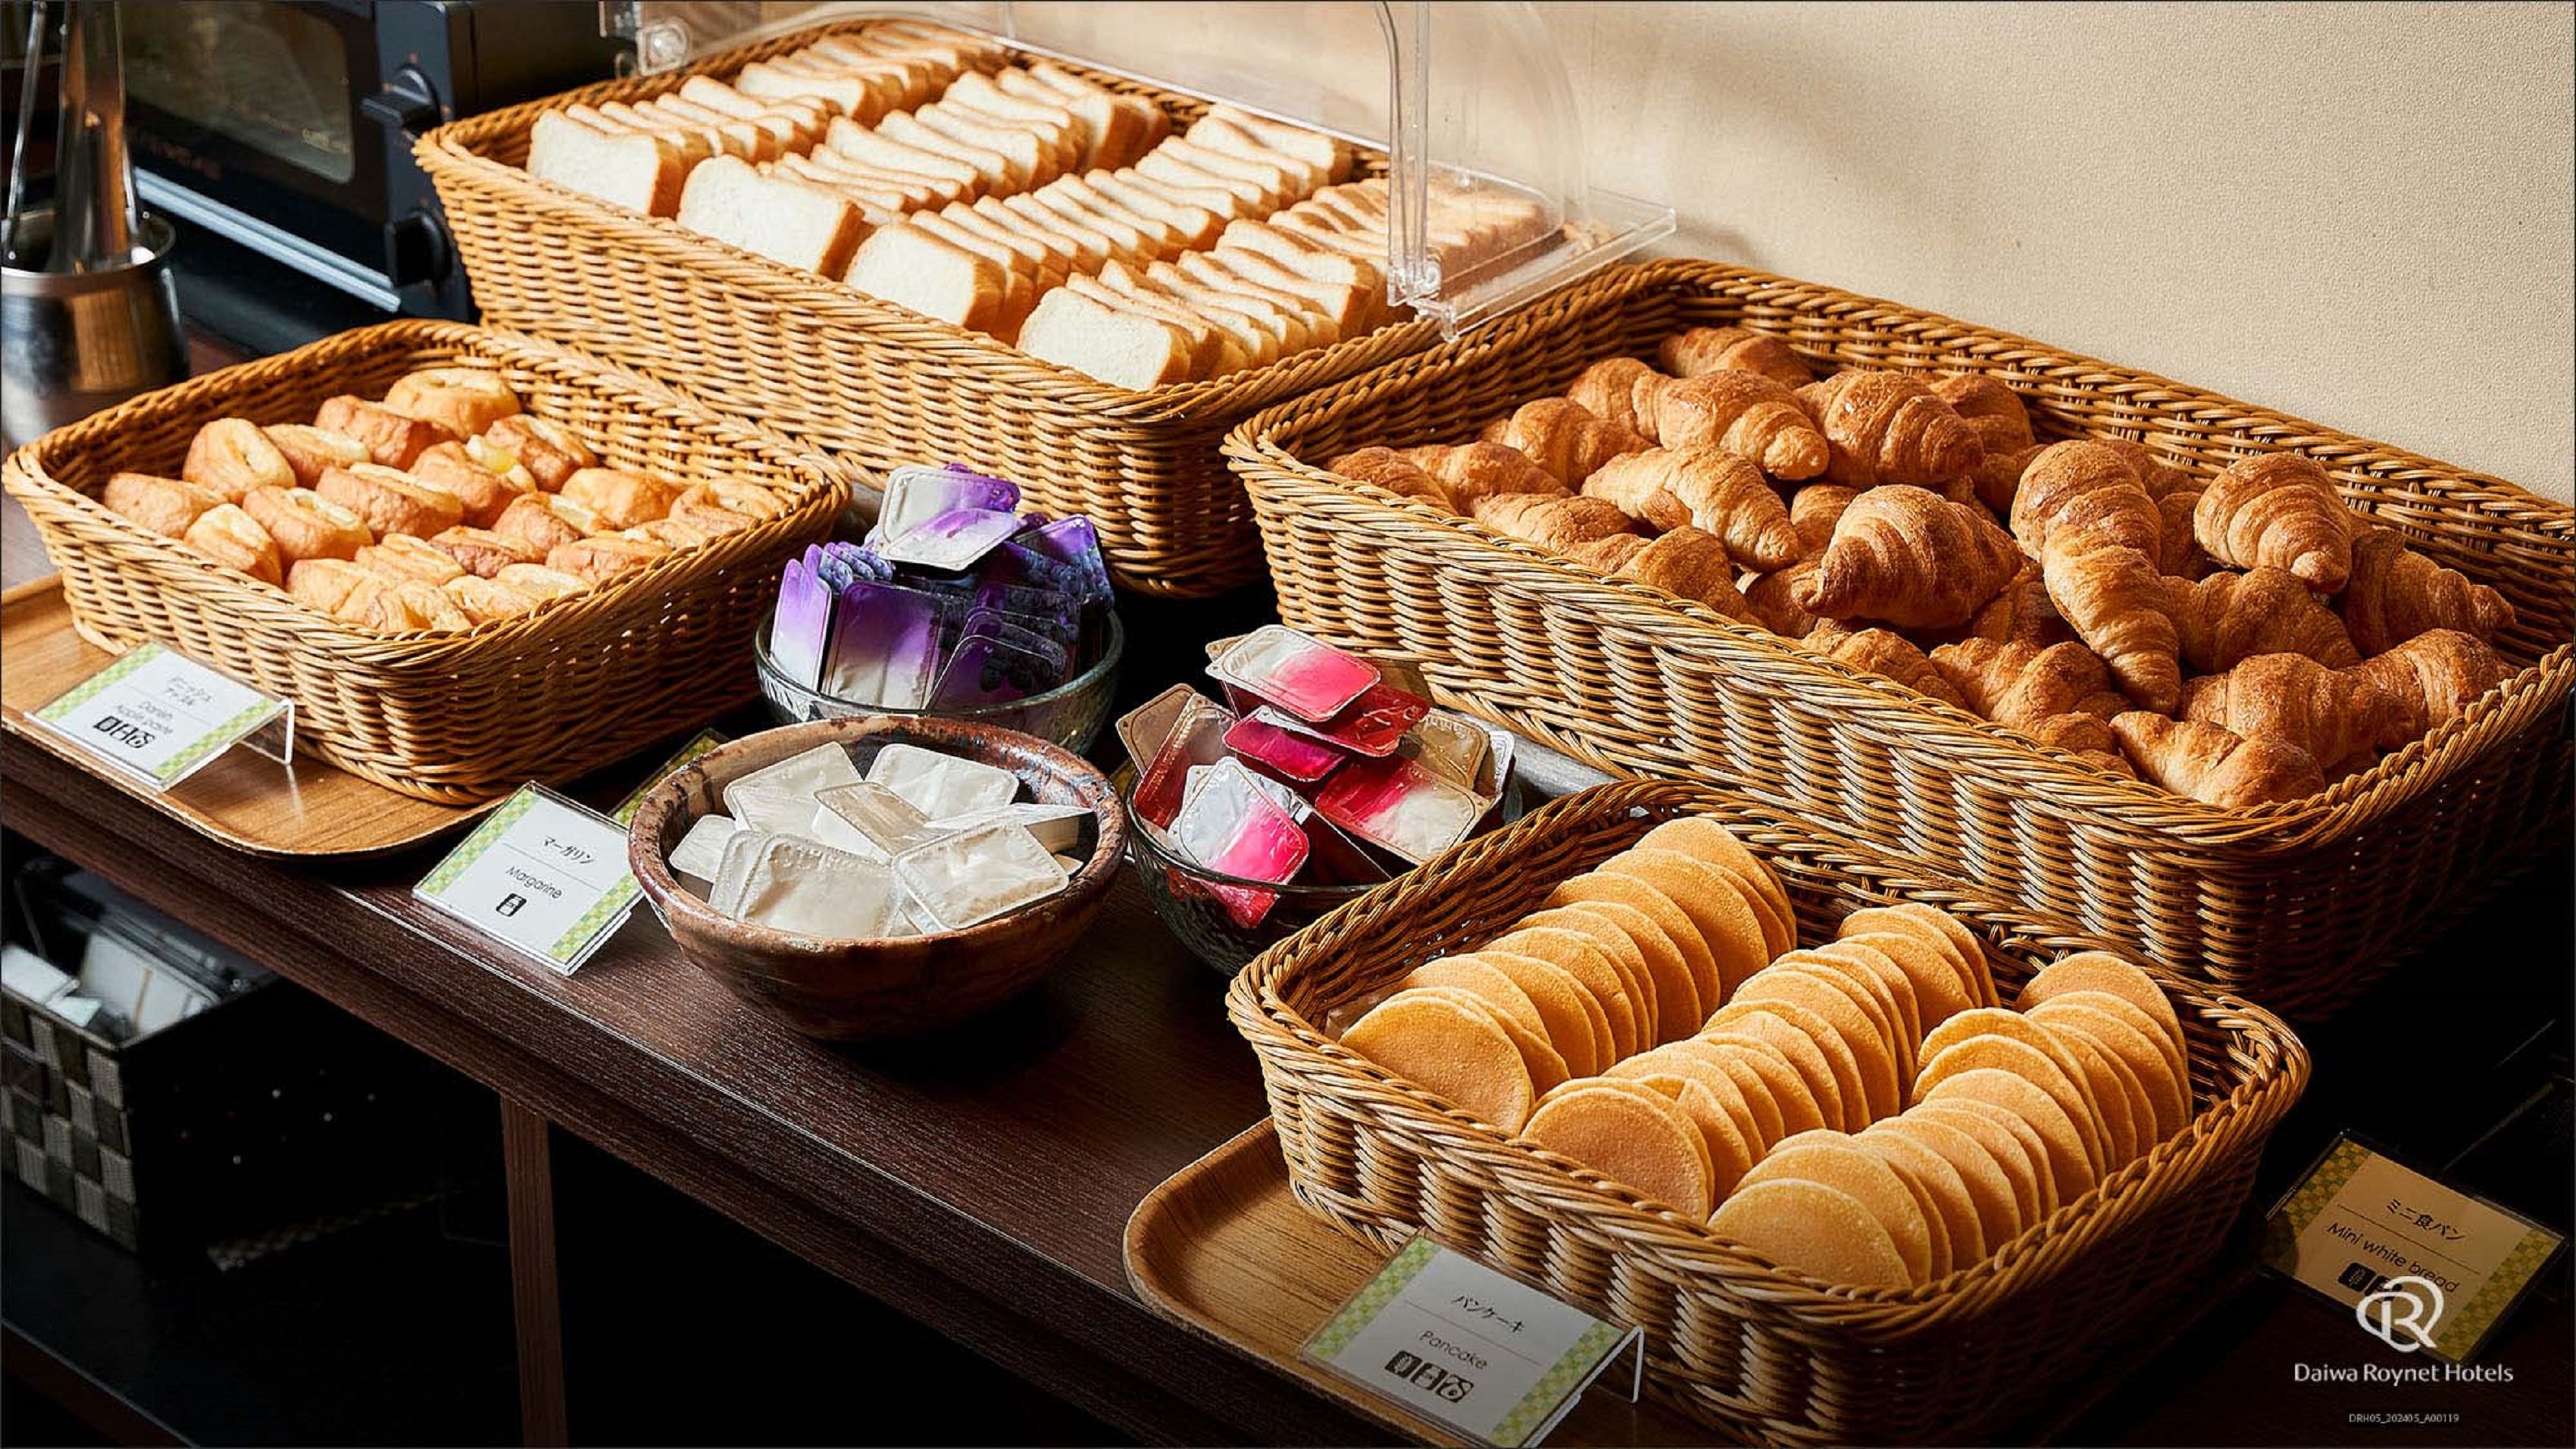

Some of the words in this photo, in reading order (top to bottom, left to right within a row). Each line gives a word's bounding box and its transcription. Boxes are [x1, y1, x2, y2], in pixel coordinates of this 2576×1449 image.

[543, 834, 595, 864] マーガリン
[505, 866, 563, 899] Margarine
[2387, 1198, 2466, 1241] ミニ食パン
[2327, 1222, 2365, 1246] Mini
[2363, 1239, 2408, 1268] white
[2408, 1260, 2461, 1293] bread
[1450, 1295, 1525, 1333] パンケーキ
[1419, 1330, 1488, 1370] Pancake
